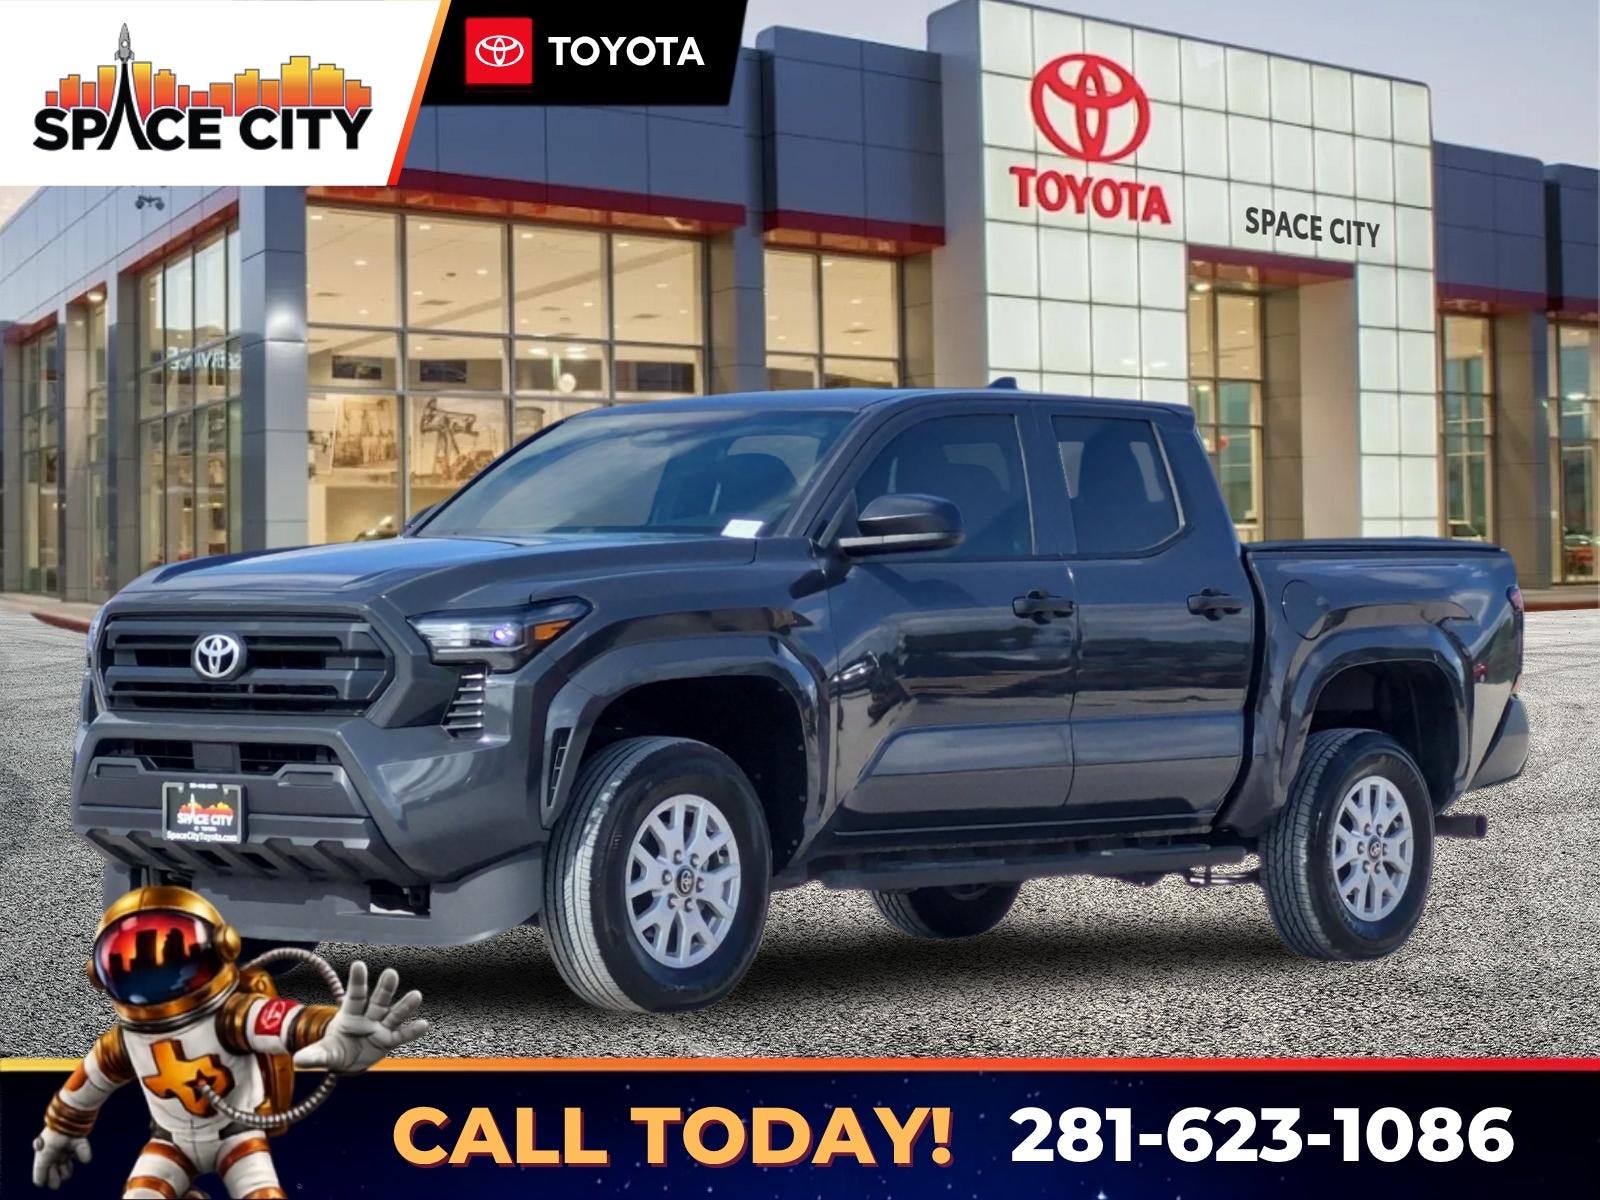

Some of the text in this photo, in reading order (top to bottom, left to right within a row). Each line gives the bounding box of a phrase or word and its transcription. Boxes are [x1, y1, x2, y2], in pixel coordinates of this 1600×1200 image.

[1009, 166, 1171, 225] TOYOTA
[1245, 207, 1381, 248] SPACE CITY
[177, 812, 233, 826] SPACE CITY
